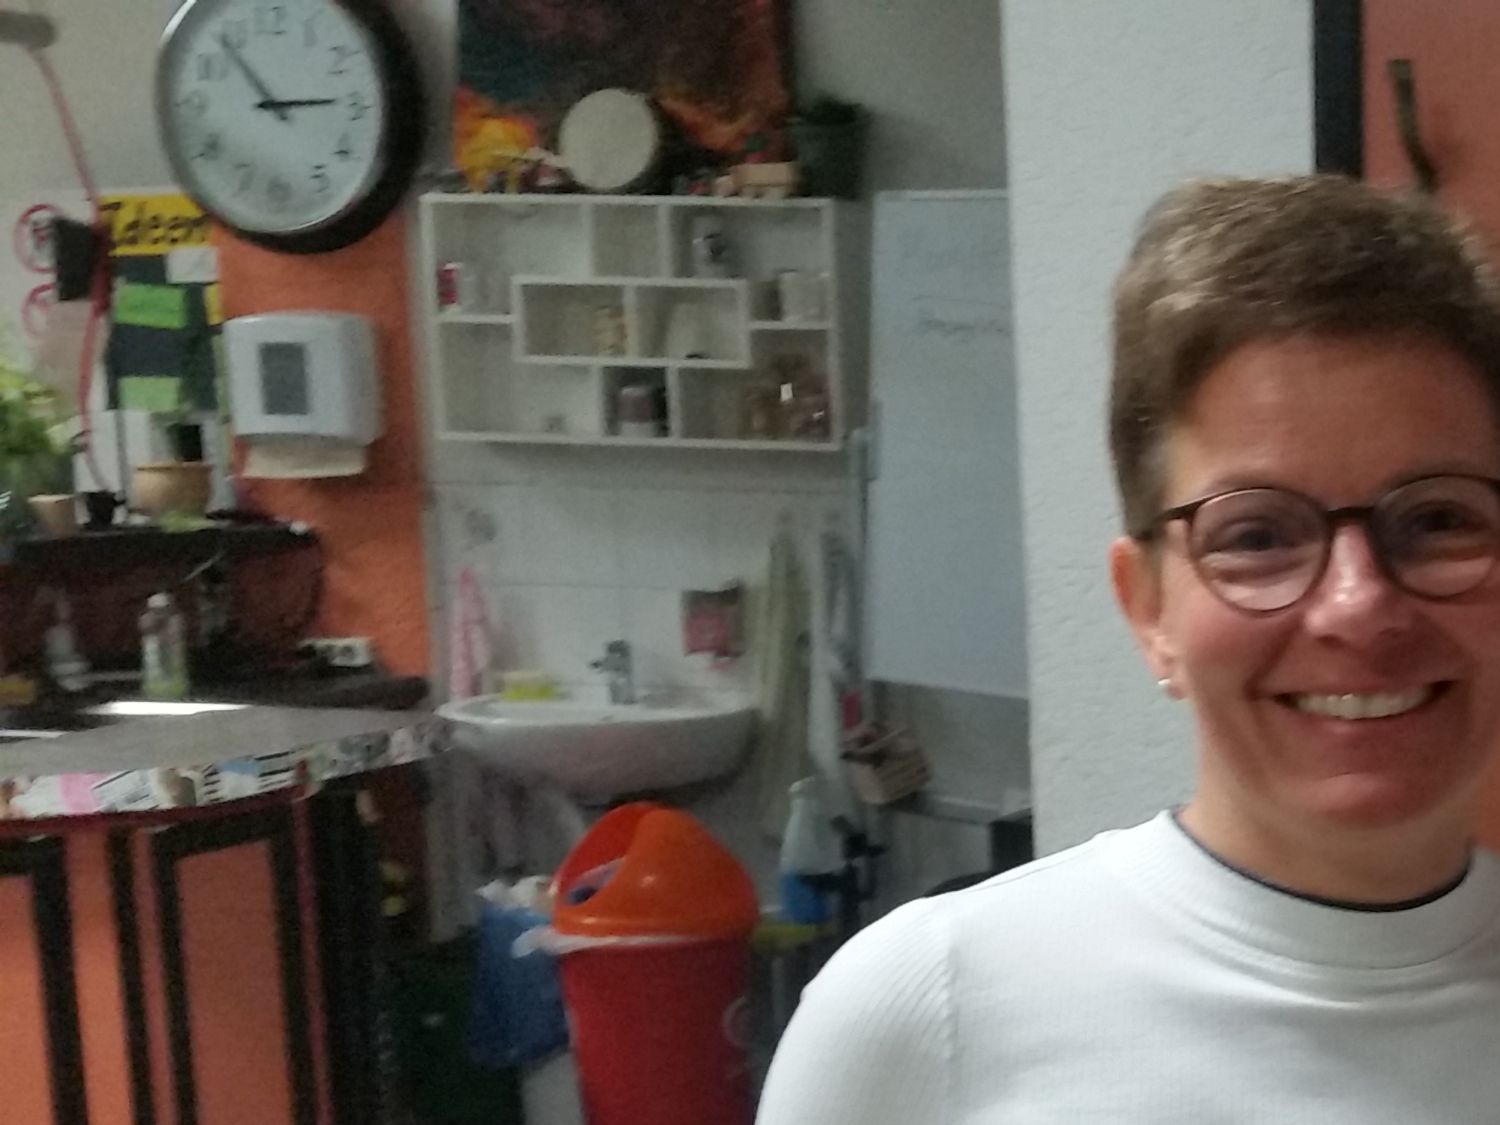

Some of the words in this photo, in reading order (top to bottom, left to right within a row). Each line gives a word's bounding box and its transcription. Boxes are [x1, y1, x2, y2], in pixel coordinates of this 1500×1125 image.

[254, 5, 287, 36] 12
[328, 45, 347, 75] 2
[348, 91, 364, 121] 3
